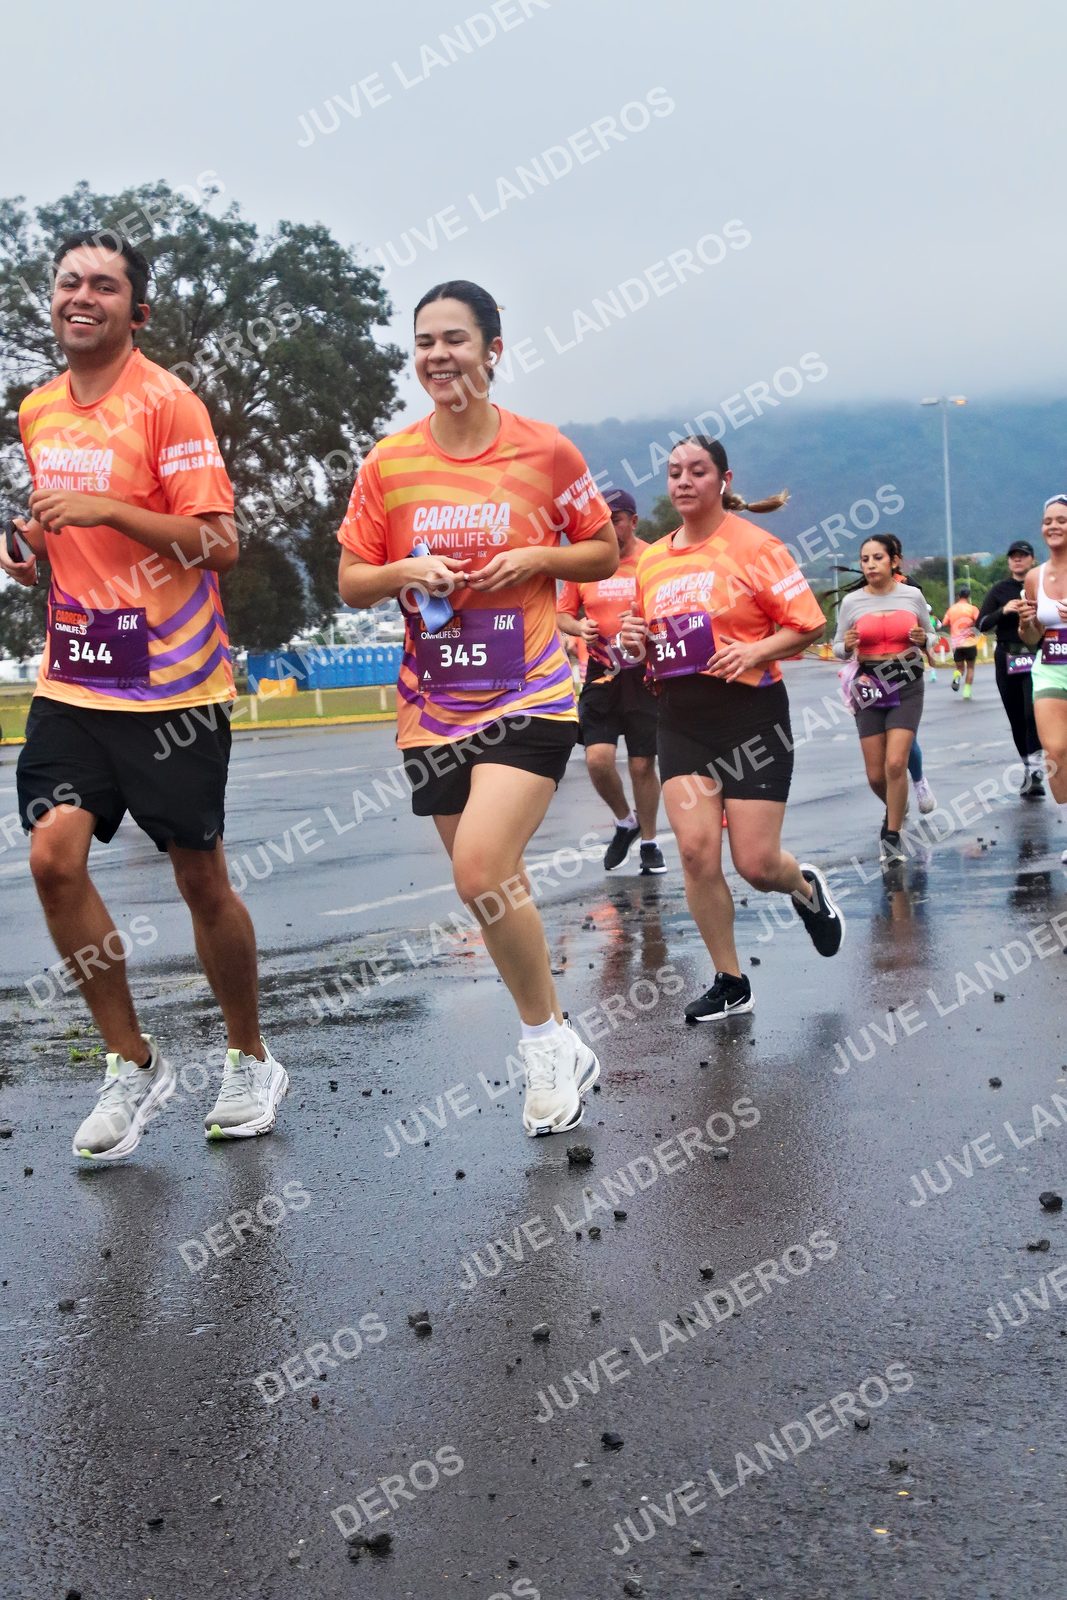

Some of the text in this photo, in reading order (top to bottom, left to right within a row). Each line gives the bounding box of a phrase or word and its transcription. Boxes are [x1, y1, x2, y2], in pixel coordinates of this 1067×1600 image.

[39, 447, 114, 472] CARRERA
[159, 438, 203, 462] TRICIÓN
[160, 455, 205, 478] IMPULSA
[38, 473, 95, 491] OMNILIFE
[413, 502, 511, 532] CARRERA
[412, 531, 485, 550] OMNILIFE
[55, 622, 79, 635] OMNILIFE
[117, 614, 139, 630] 15K
[493, 614, 516, 631] 15K
[69, 639, 113, 664] 344
[440, 643, 488, 668] 345
[655, 639, 688, 662] 341
[1049, 643, 1067, 655] 398
[1015, 656, 1033, 667] 604
[862, 687, 883, 699] 514
